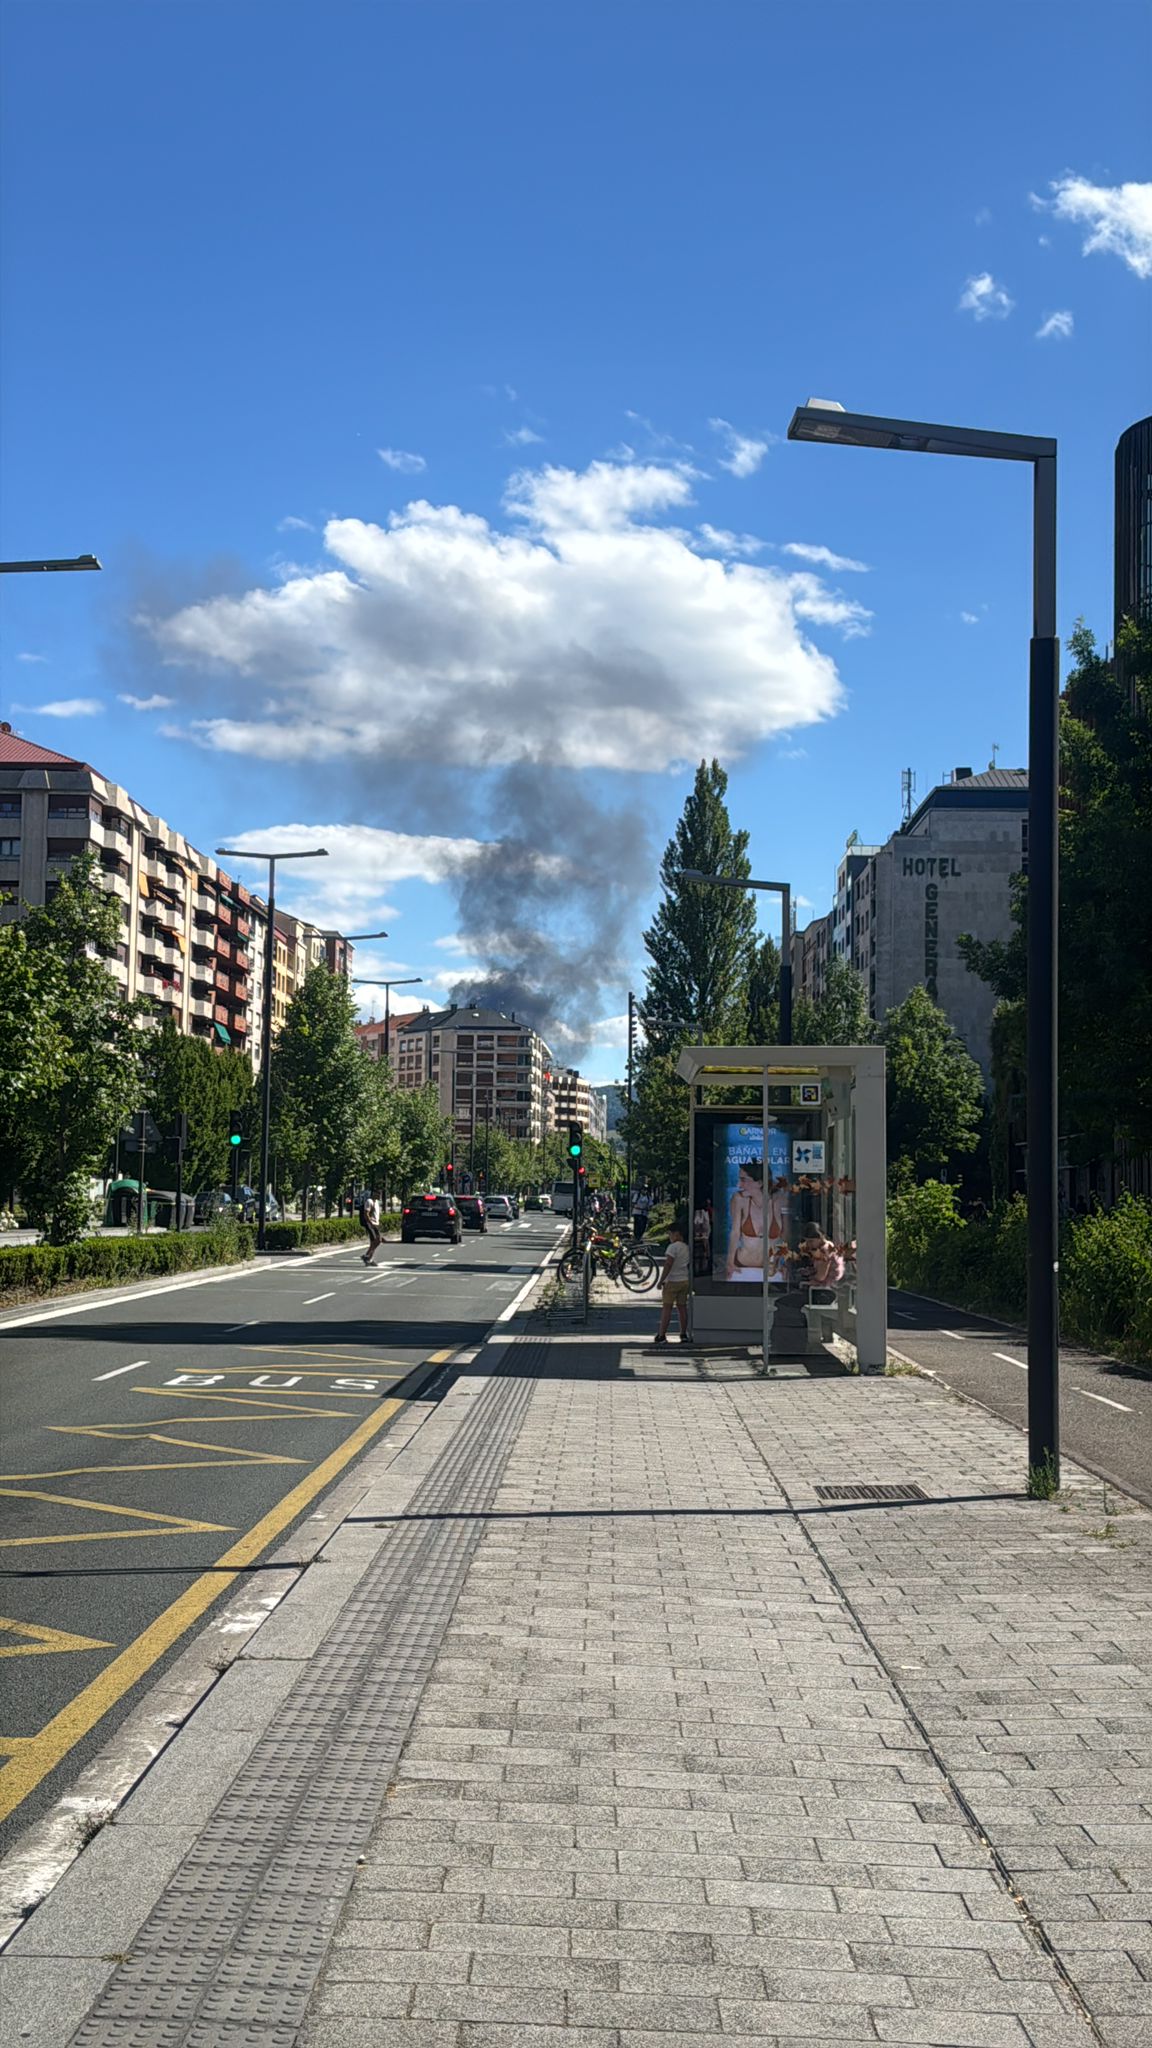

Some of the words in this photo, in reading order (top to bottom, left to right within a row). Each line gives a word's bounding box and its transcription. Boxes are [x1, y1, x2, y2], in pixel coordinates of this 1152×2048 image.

[903, 857, 961, 877] HOTEL
[925, 883, 938, 1001] GENERA
[739, 1127, 777, 1136] GARNR
[728, 1144, 764, 1156] BÁÑAT
[773, 1147, 787, 1156] EN
[726, 1156, 754, 1164] AGUA
[163, 1374, 380, 1390] BUS
